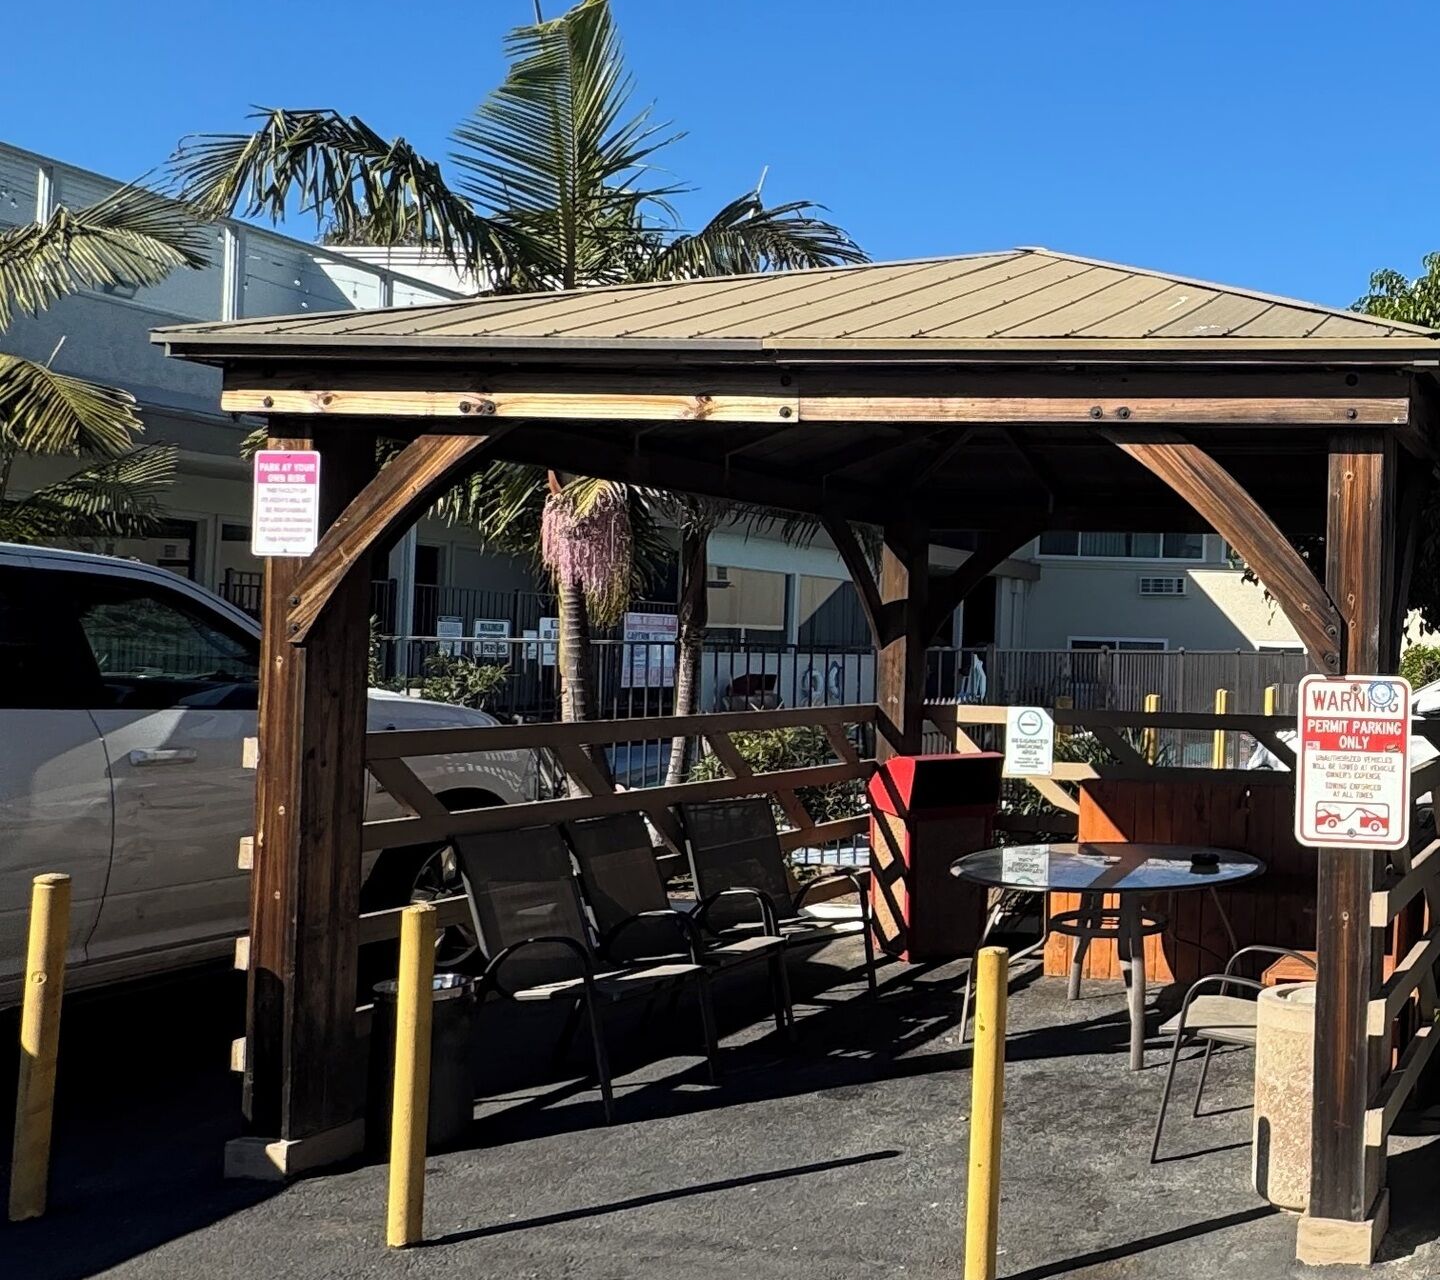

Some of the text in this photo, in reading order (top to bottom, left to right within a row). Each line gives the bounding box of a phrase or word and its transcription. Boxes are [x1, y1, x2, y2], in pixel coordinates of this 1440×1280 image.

[259, 462, 315, 472] PARK AT YOUR
[267, 473, 285, 483] OWN
[484, 643, 506, 653] PERSNS
[1307, 719, 1402, 736] PERMIT PARKING
[1339, 735, 1370, 749] ONLY
